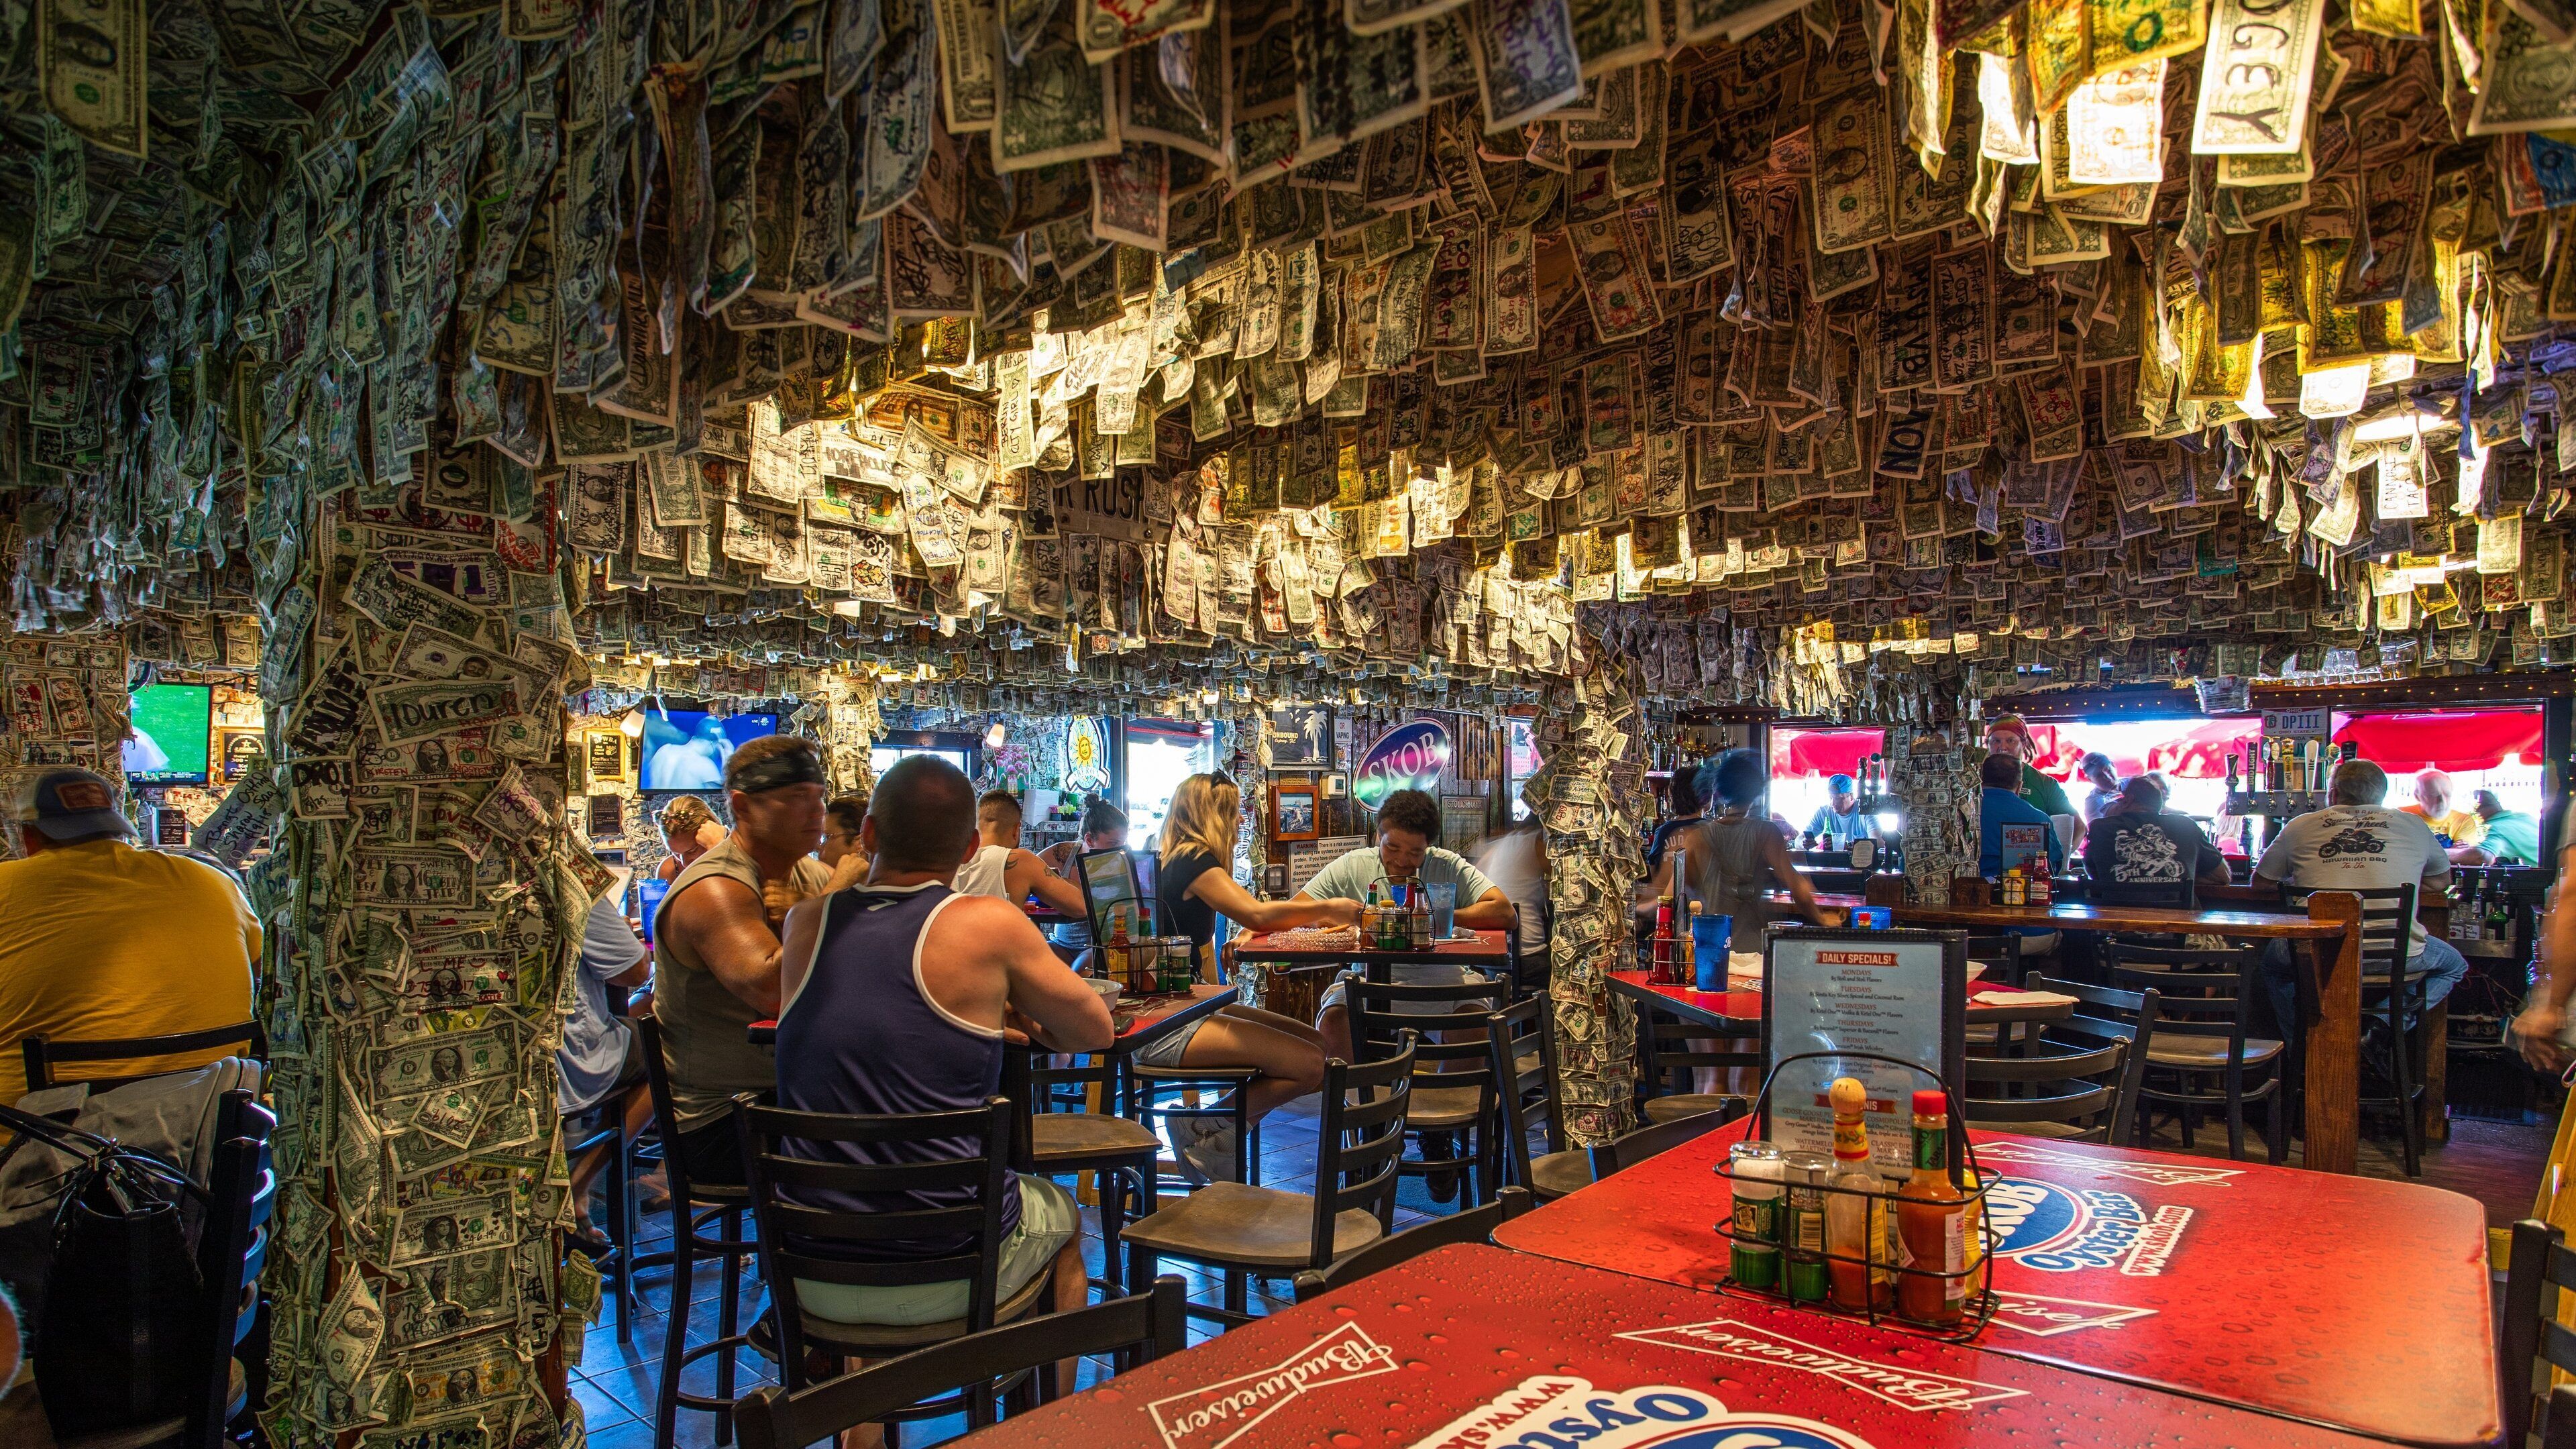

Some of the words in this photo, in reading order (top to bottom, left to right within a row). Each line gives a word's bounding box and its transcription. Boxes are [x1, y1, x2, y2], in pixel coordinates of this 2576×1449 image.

[2282, 714, 2319, 729] DPIII
[1336, 731, 1350, 739] VAPING
[1368, 733, 1440, 797] SKOB
[2319, 810, 2350, 820] TOMMY
[2356, 810, 2394, 818] BAHAMA
[419, 861, 453, 869] SWEET
[2110, 865, 2140, 882] 5TH
[1823, 953, 1845, 963] DAILY
[1848, 954, 1892, 965] SPECIALS!
[1800, 1116, 1825, 1124] MARTINI
[1867, 1116, 1911, 1124] COSMOPOLITA
[1795, 1138, 1833, 1146] WATERMELO
[1969, 1145, 2233, 1187] Budweise
[1979, 1183, 2048, 1250] KOB
[2020, 1218, 2140, 1271] Oyster
[2092, 1191, 2141, 1222] Bar
[2127, 1205, 2189, 1276] www.skob.com
[1674, 1324, 1973, 1411] Budweiser
[1163, 1340, 1393, 1443] Budweiser
